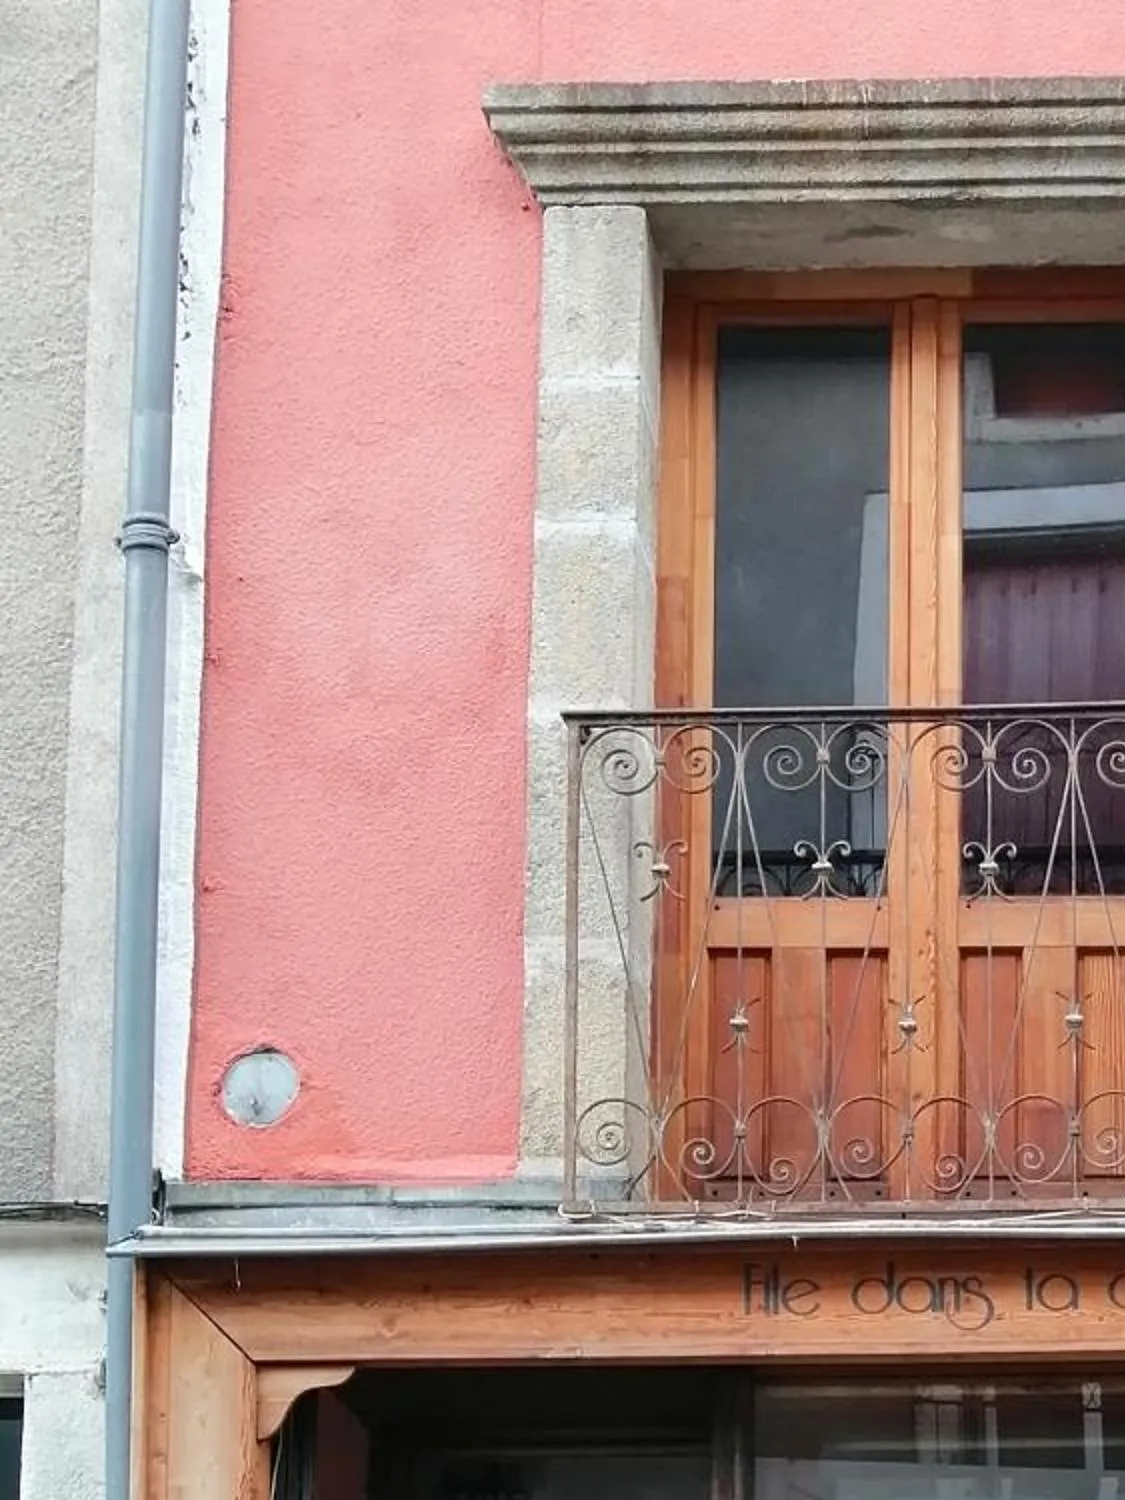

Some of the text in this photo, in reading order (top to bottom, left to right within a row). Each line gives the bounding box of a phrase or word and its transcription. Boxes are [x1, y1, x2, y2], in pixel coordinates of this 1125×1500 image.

[741, 1263, 822, 1317] File
[851, 1261, 998, 1331] dans
[1026, 1268, 1080, 1312] ta
